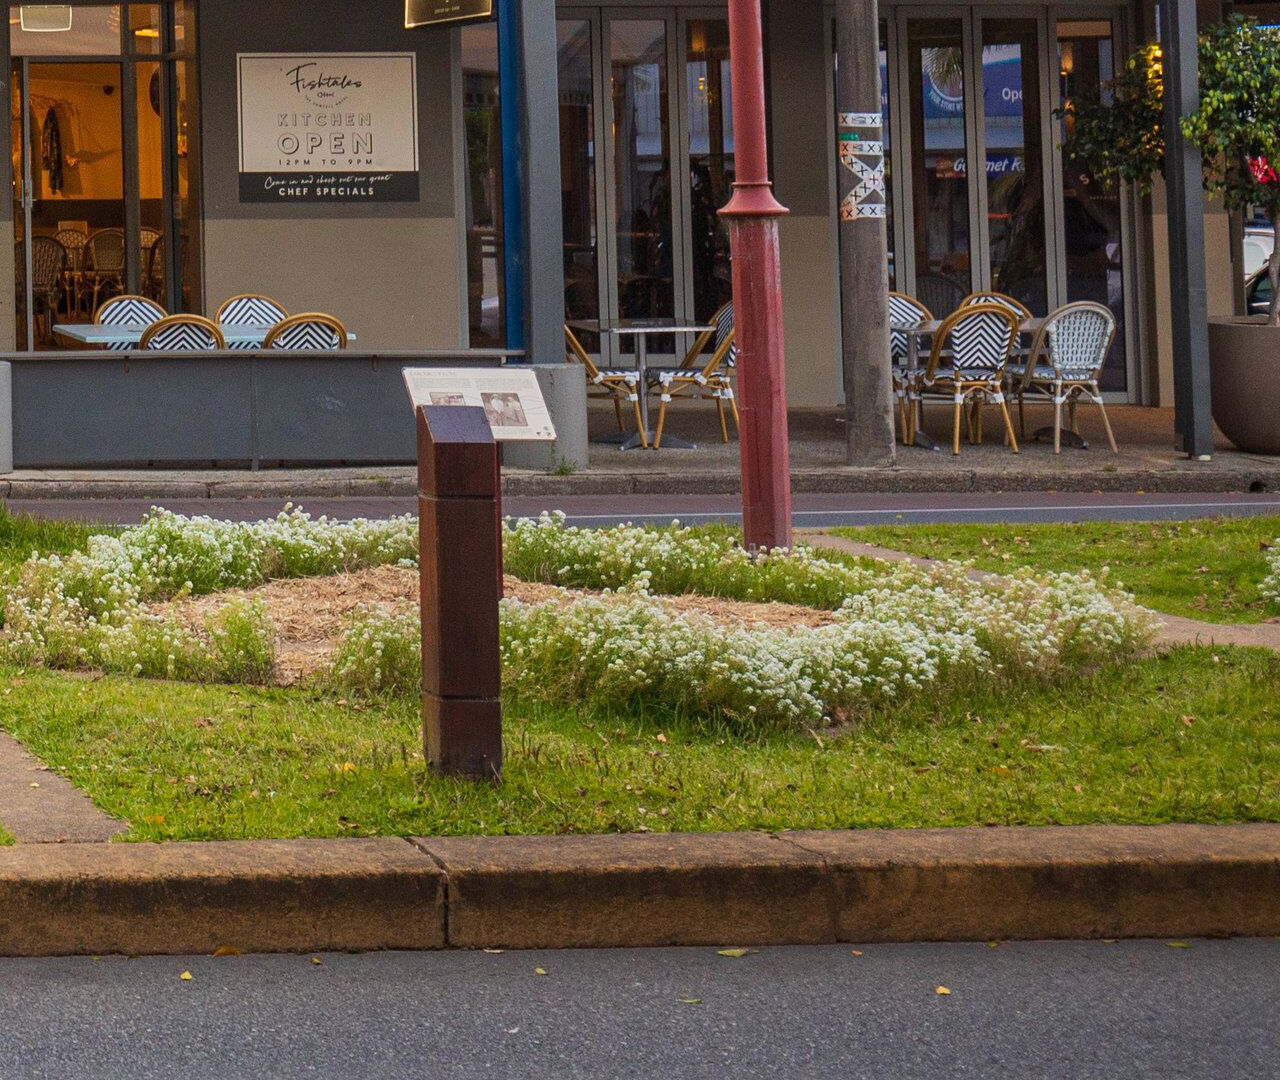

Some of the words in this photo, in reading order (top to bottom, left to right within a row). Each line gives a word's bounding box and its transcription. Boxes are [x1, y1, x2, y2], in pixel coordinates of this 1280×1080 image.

[286, 62, 362, 93] Fishtales
[1002, 87, 1023, 103] Ope
[277, 113, 371, 127] KITCHEN
[277, 133, 373, 155] OPEN
[264, 176, 286, 190] Come
[300, 174, 314, 184] and
[369, 174, 393, 184] great
[279, 187, 308, 195] CHEF
[316, 187, 374, 195] SPECIALS
